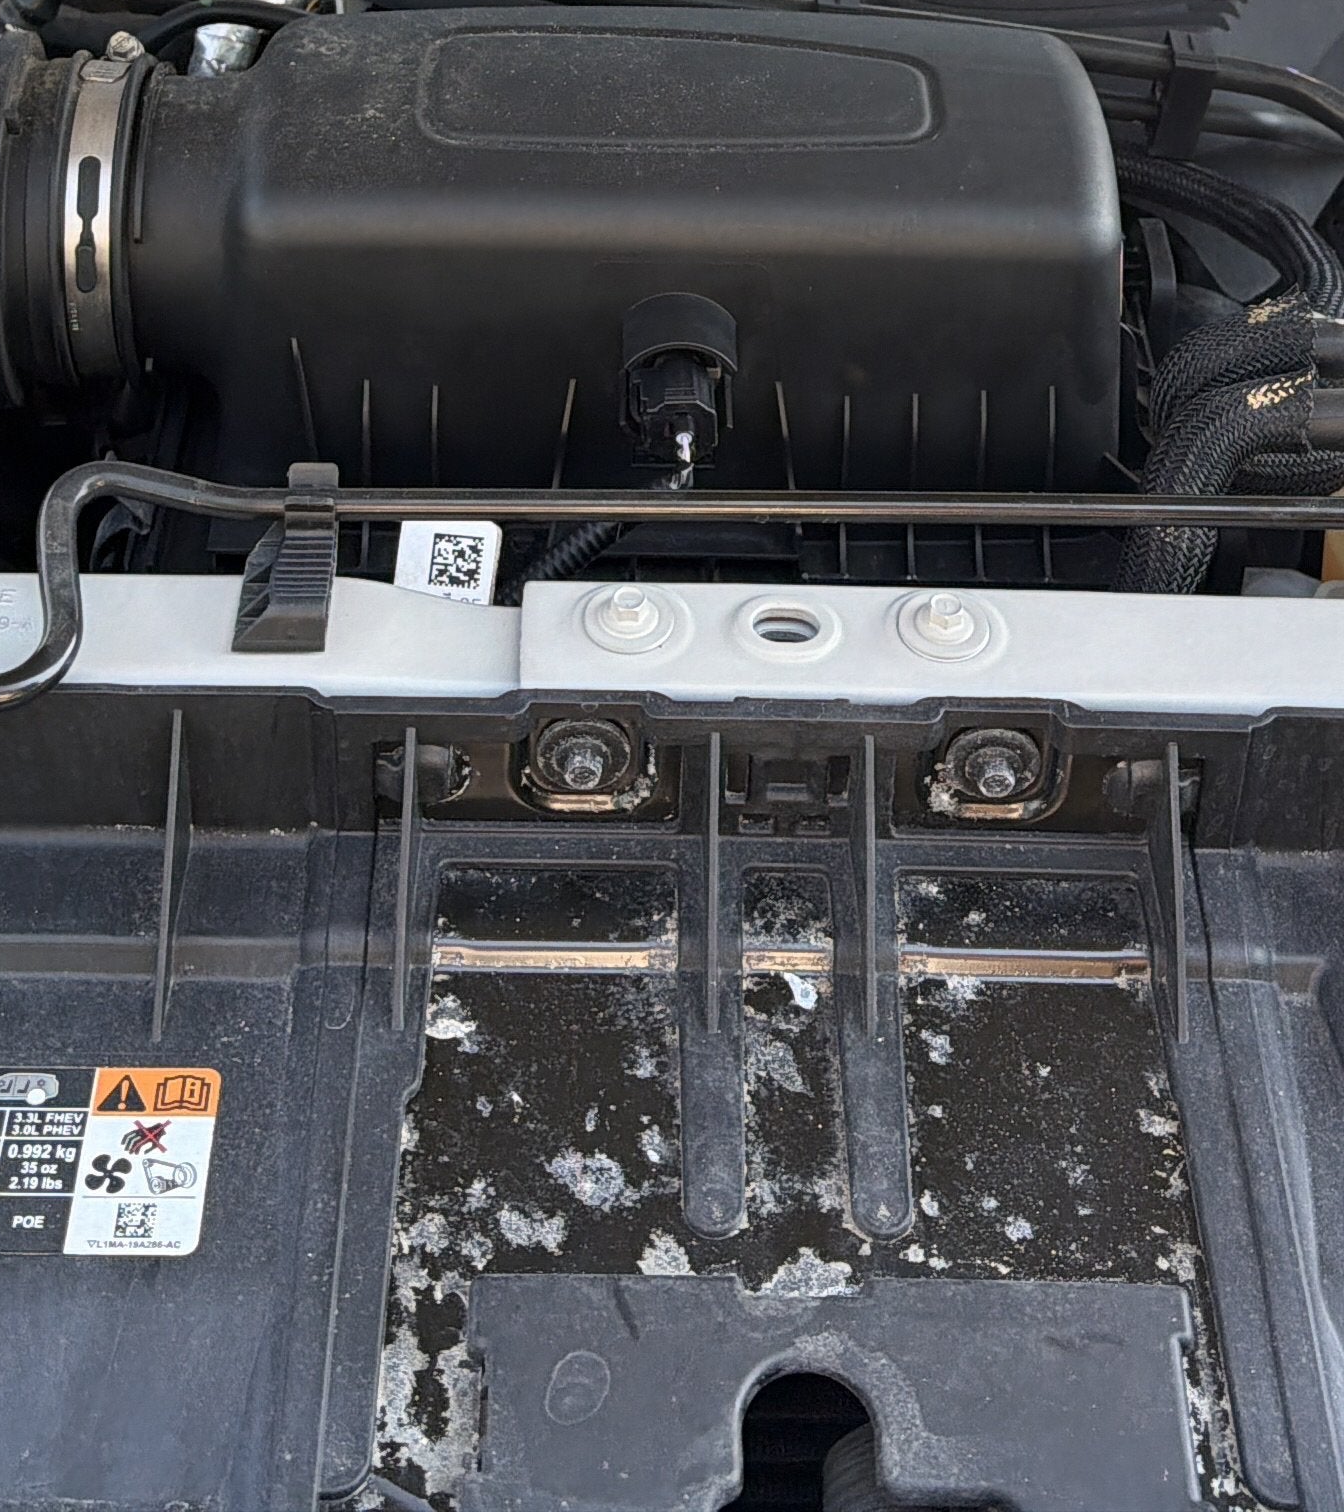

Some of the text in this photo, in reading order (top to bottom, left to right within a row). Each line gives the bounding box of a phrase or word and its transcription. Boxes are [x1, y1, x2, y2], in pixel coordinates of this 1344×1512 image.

[13, 1113, 84, 1124] 3.3L FHEV
[11, 1124, 82, 1136] 3.0L PHEV
[8, 1144, 76, 1162] 0.992 kg
[20, 1163, 58, 1174] 35 oz
[9, 1177, 63, 1189] 2.19 lbs
[12, 1216, 45, 1229] POE
